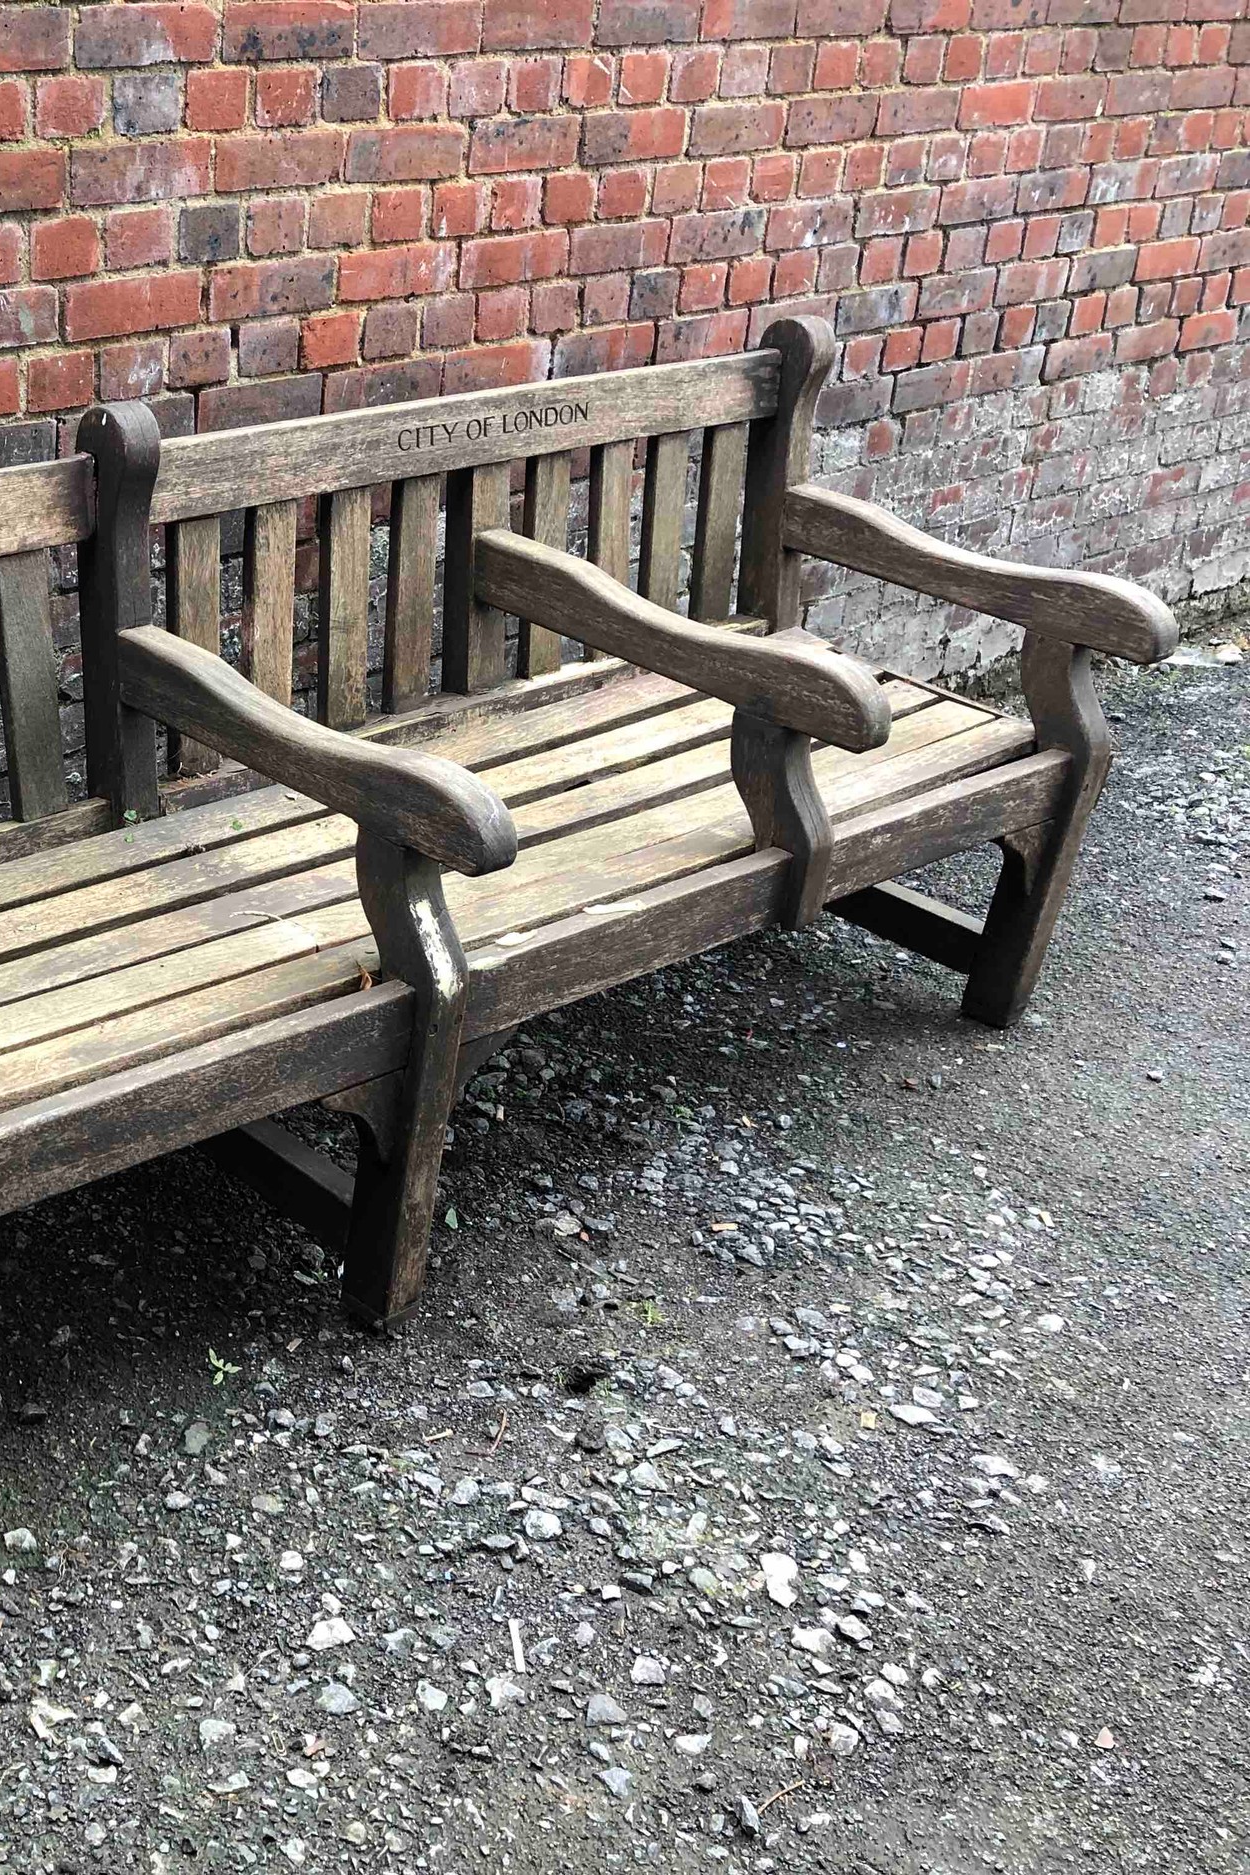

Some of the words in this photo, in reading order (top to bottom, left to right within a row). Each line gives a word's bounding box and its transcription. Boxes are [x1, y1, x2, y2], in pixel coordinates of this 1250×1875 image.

[397, 422, 458, 451] CITY
[466, 416, 495, 441] OF
[502, 401, 589, 434] LONDON
